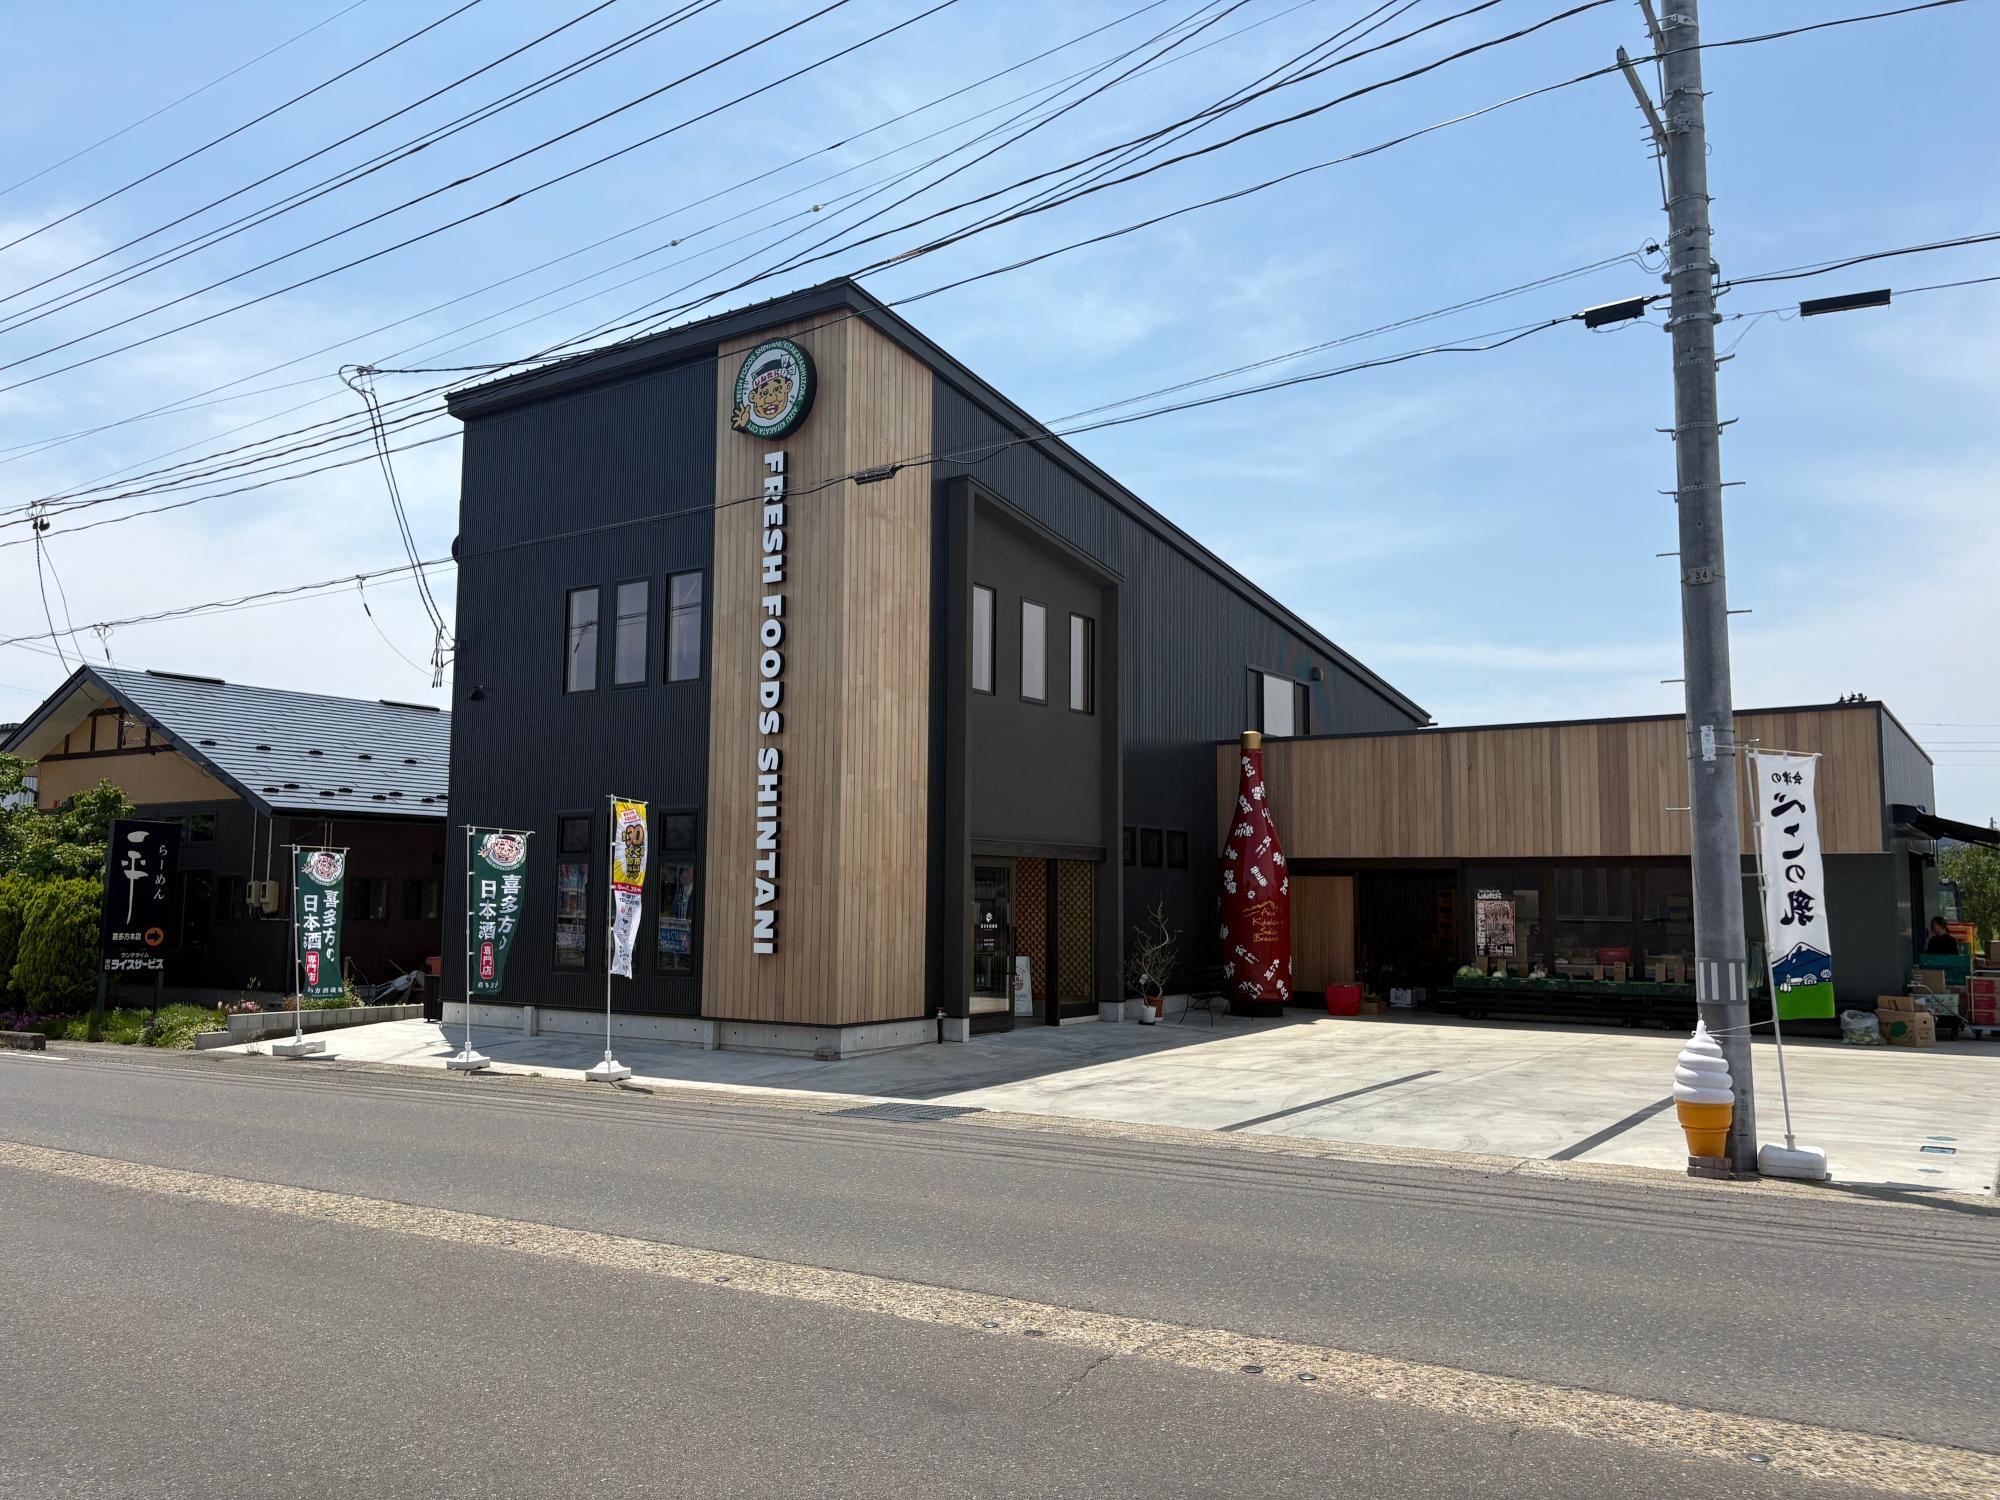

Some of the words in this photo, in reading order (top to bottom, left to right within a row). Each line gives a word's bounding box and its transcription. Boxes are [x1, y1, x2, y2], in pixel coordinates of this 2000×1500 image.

[762, 450, 785, 584] FRESH
[758, 594, 783, 735] FOODS
[153, 844, 168, 900] らーめん
[753, 747, 780, 955] SHINTANI
[112, 932, 142, 941] 喜多方本店
[303, 894, 322, 950] 日本酒
[478, 879, 497, 940] 日本酒
[111, 958, 164, 970] ライスサービス
